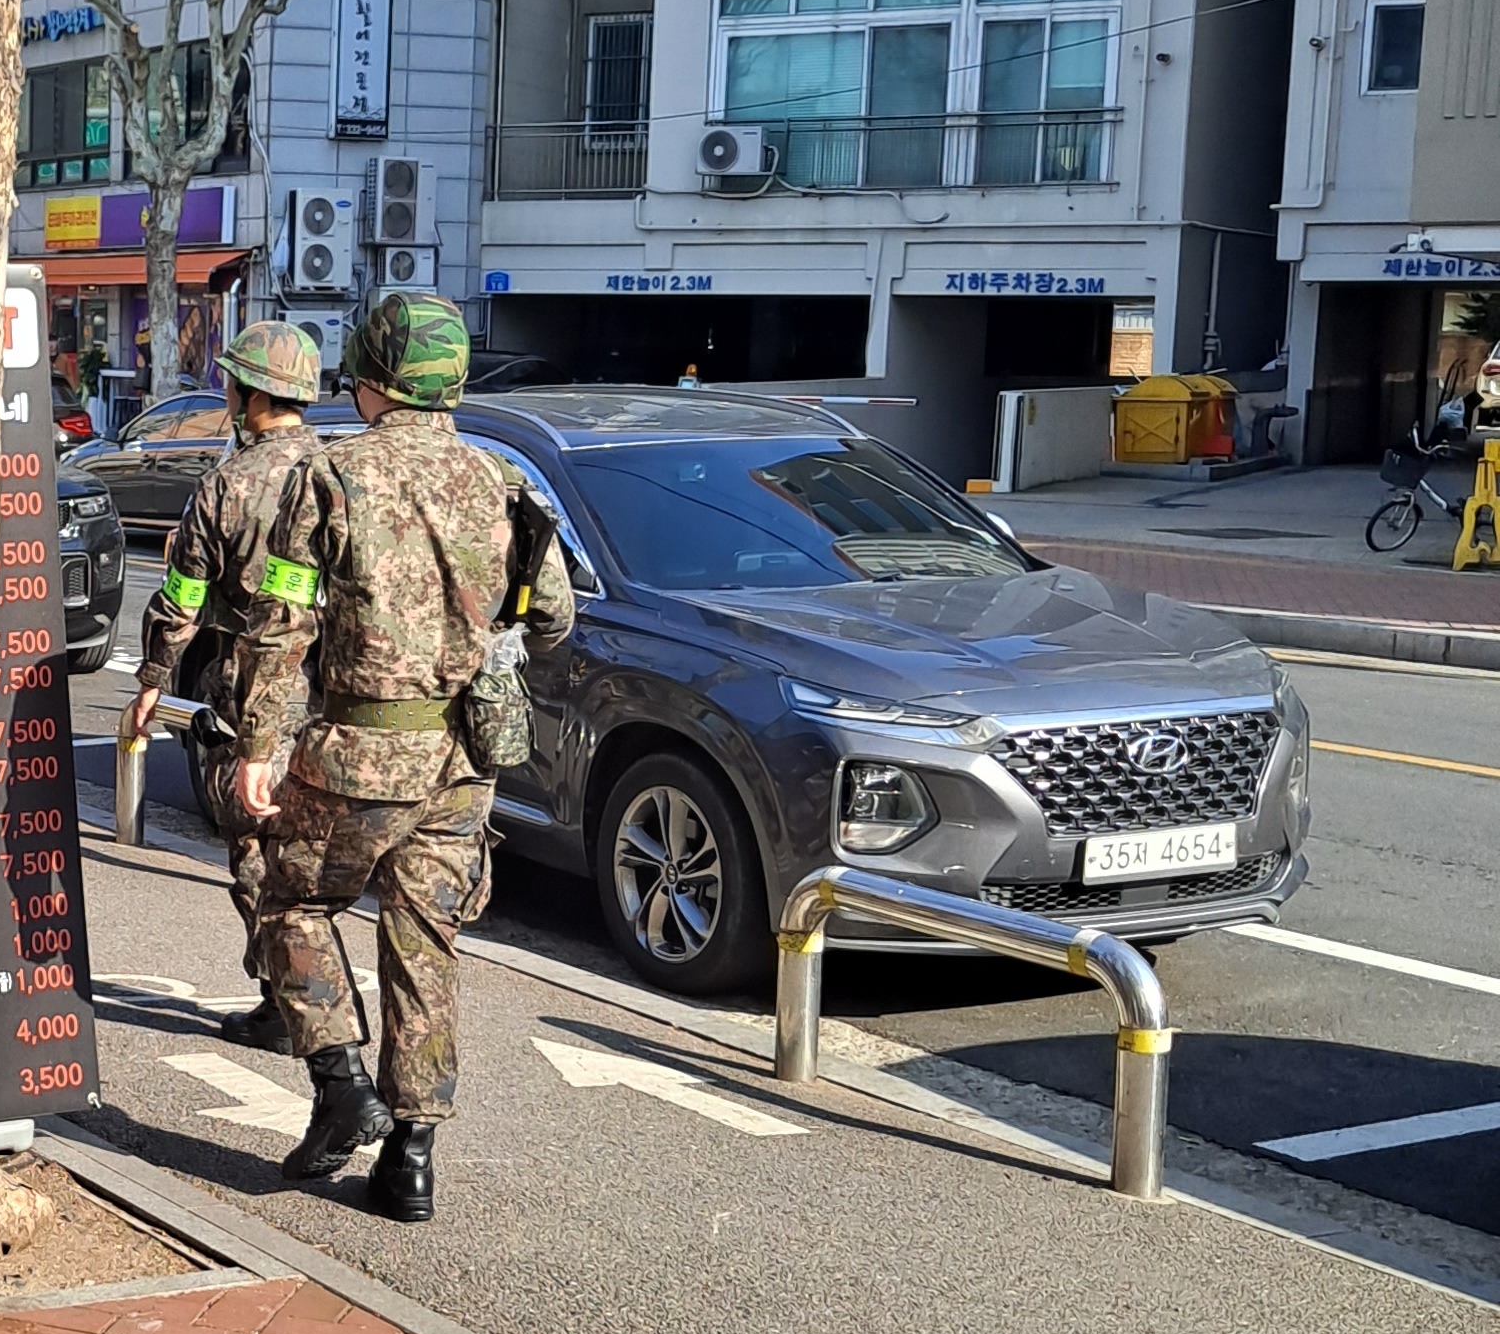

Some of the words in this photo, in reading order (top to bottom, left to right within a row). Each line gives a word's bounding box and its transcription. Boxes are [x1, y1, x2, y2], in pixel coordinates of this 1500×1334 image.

[670, 275, 712, 292] 2.3M
[0, 850, 65, 881] 7,500
[1099, 840, 1148, 872] 35저
[1160, 831, 1223, 864] 4654
[11, 892, 69, 924] 1,000
[13, 929, 72, 960] 1,000
[16, 964, 74, 995] 1,000
[17, 1013, 79, 1045] 4,000
[20, 1061, 83, 1095] 3,500
